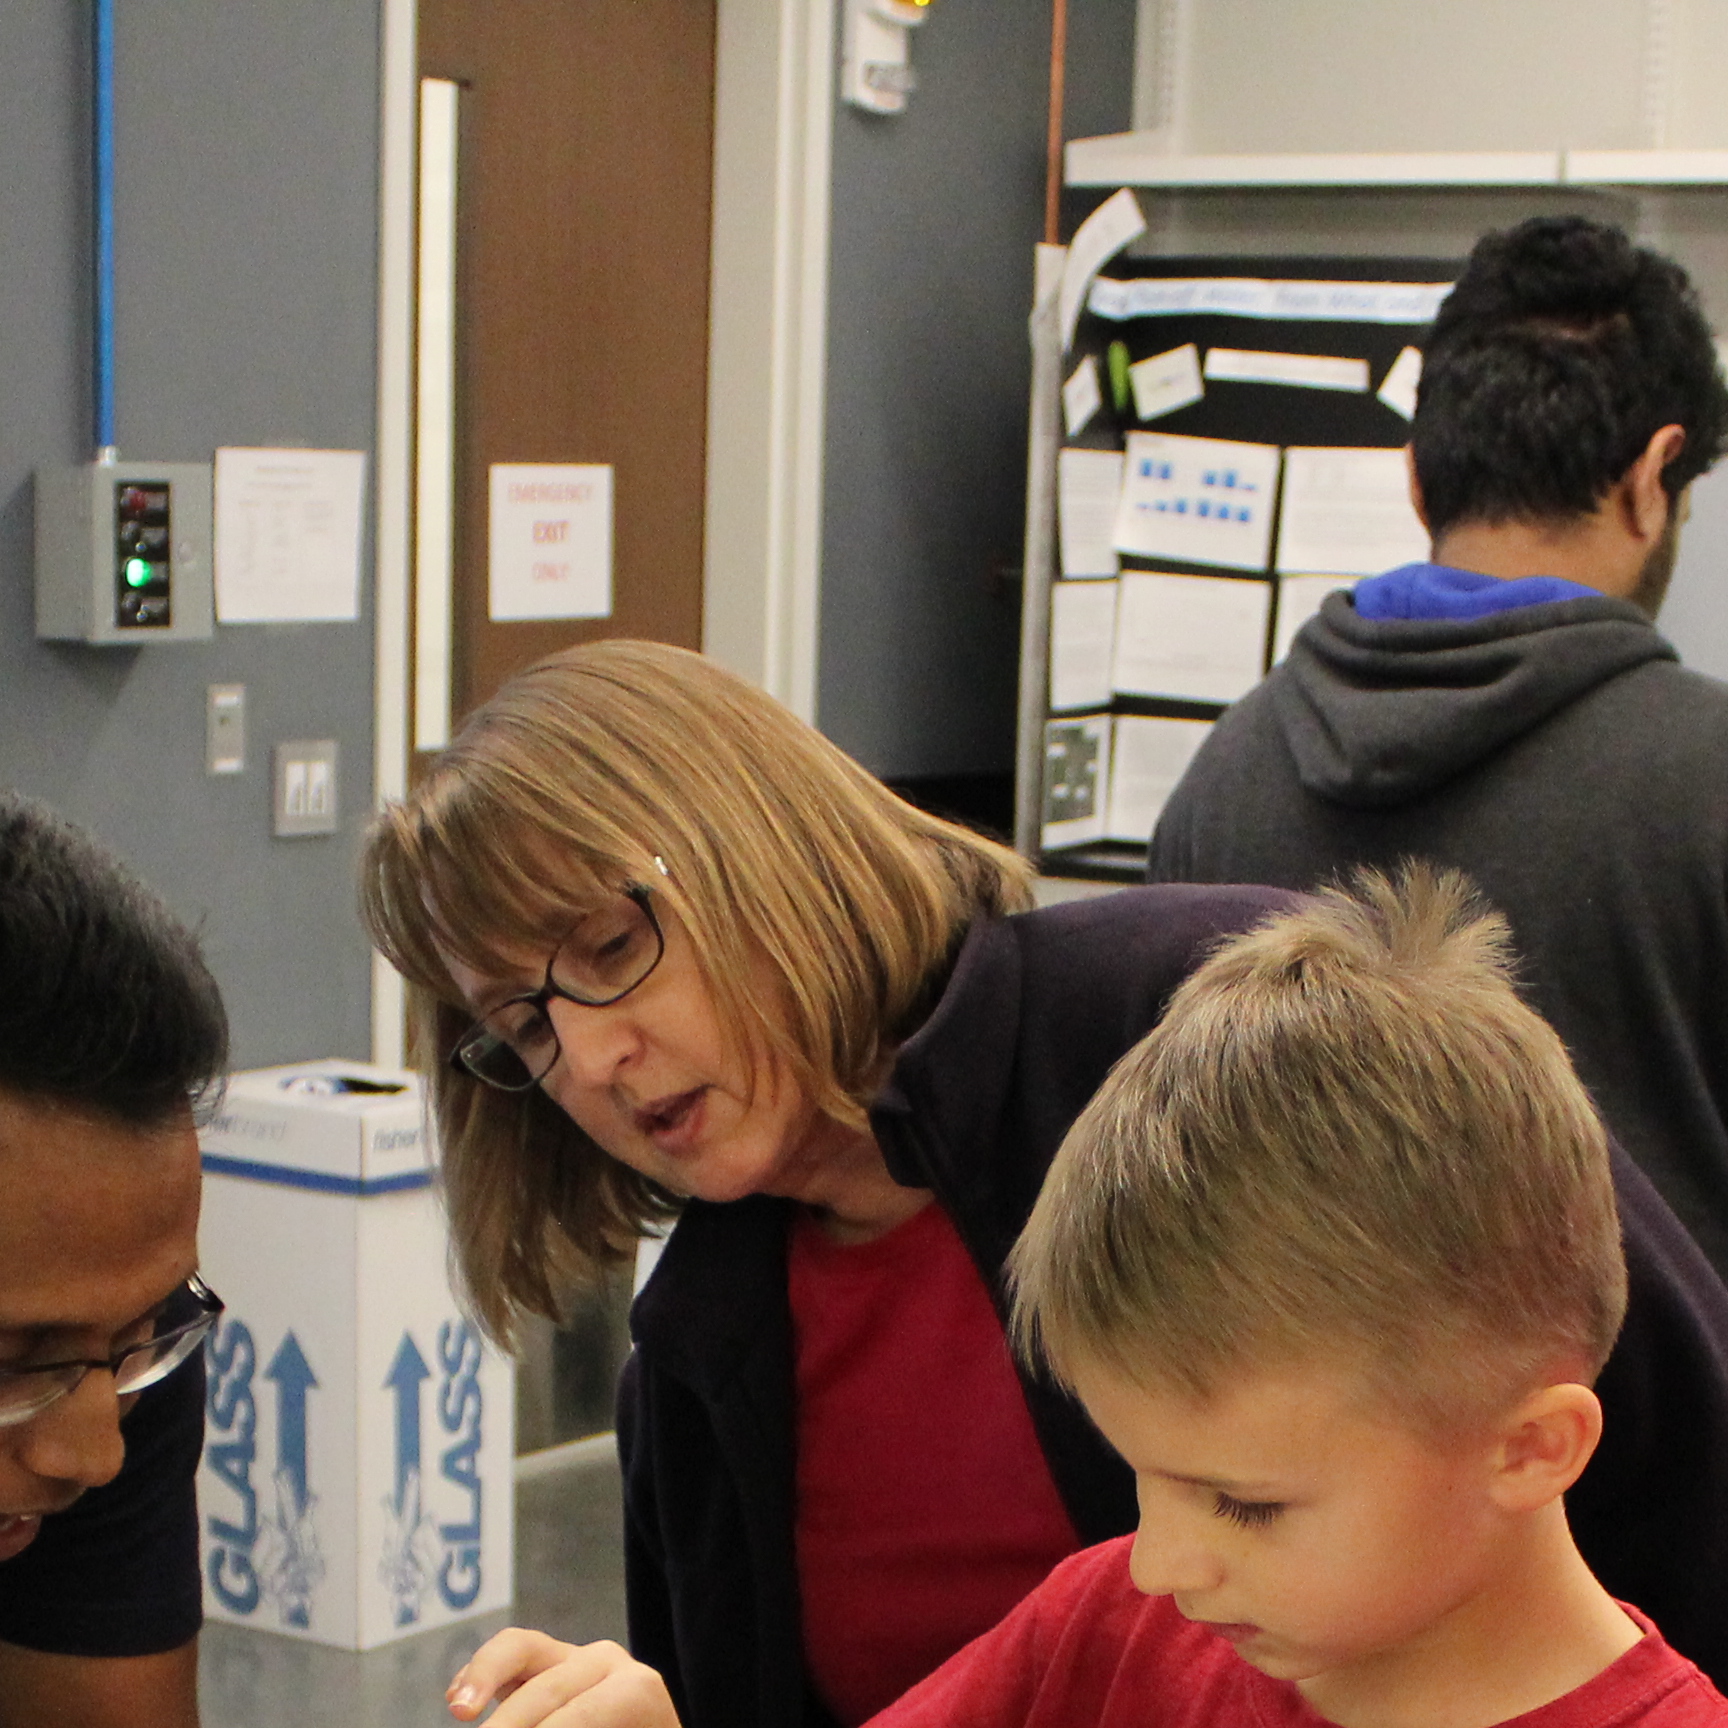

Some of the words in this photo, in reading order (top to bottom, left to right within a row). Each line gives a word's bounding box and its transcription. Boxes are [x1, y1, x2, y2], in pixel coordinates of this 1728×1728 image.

[508, 482, 594, 503] EMERGENCY
[533, 519, 571, 544] EXIT
[206, 1317, 260, 1616] GLASS
[437, 1317, 484, 1613] GLASS
